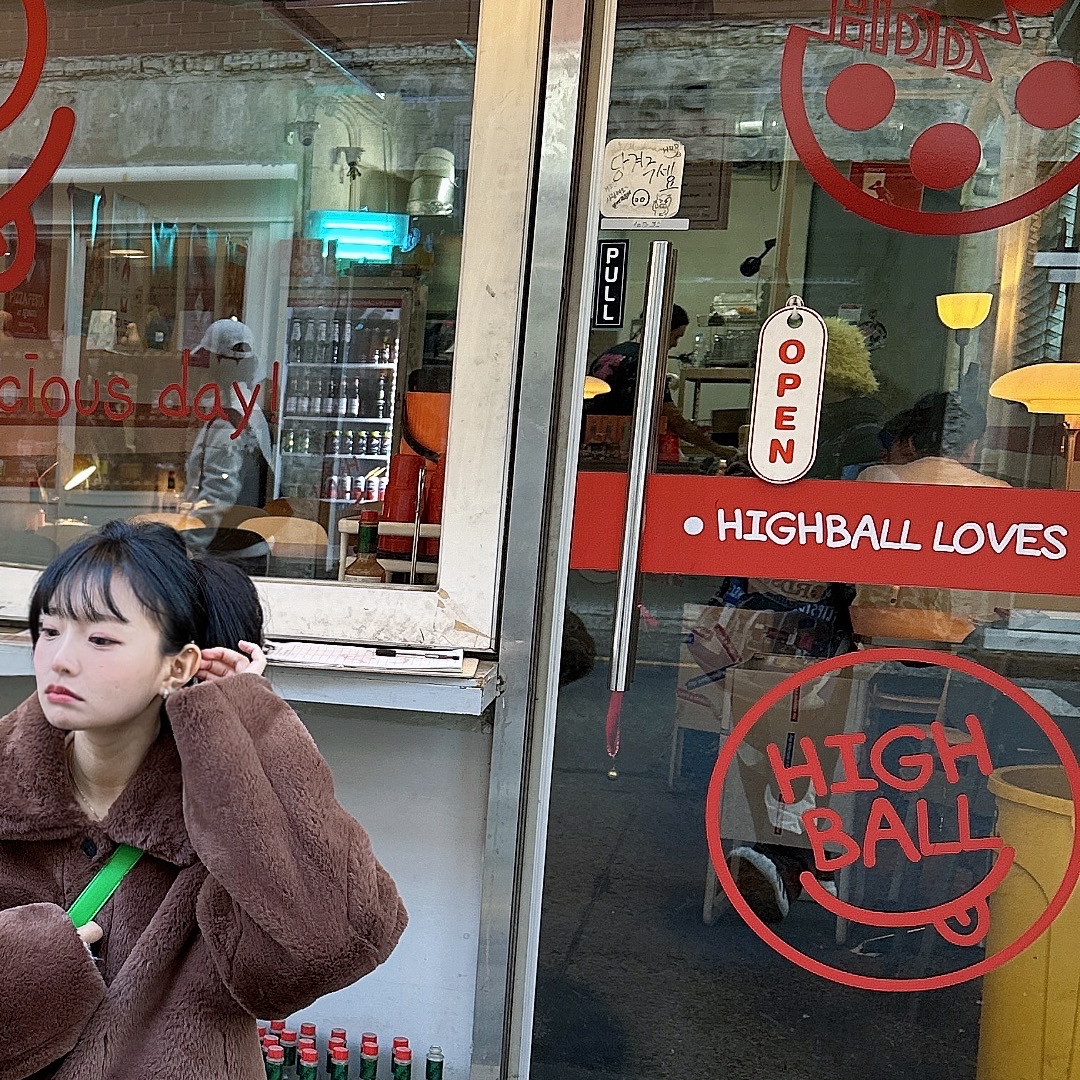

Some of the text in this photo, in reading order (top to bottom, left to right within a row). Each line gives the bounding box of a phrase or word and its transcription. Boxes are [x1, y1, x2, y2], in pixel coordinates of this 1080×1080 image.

[603, 247, 620, 322] PULL
[158, 348, 280, 440] day!
[768, 338, 806, 465] OPEN
[717, 508, 1069, 560] HIGHBALL LOVES
[766, 714, 994, 804] HIGH
[801, 794, 1005, 872] BALL
